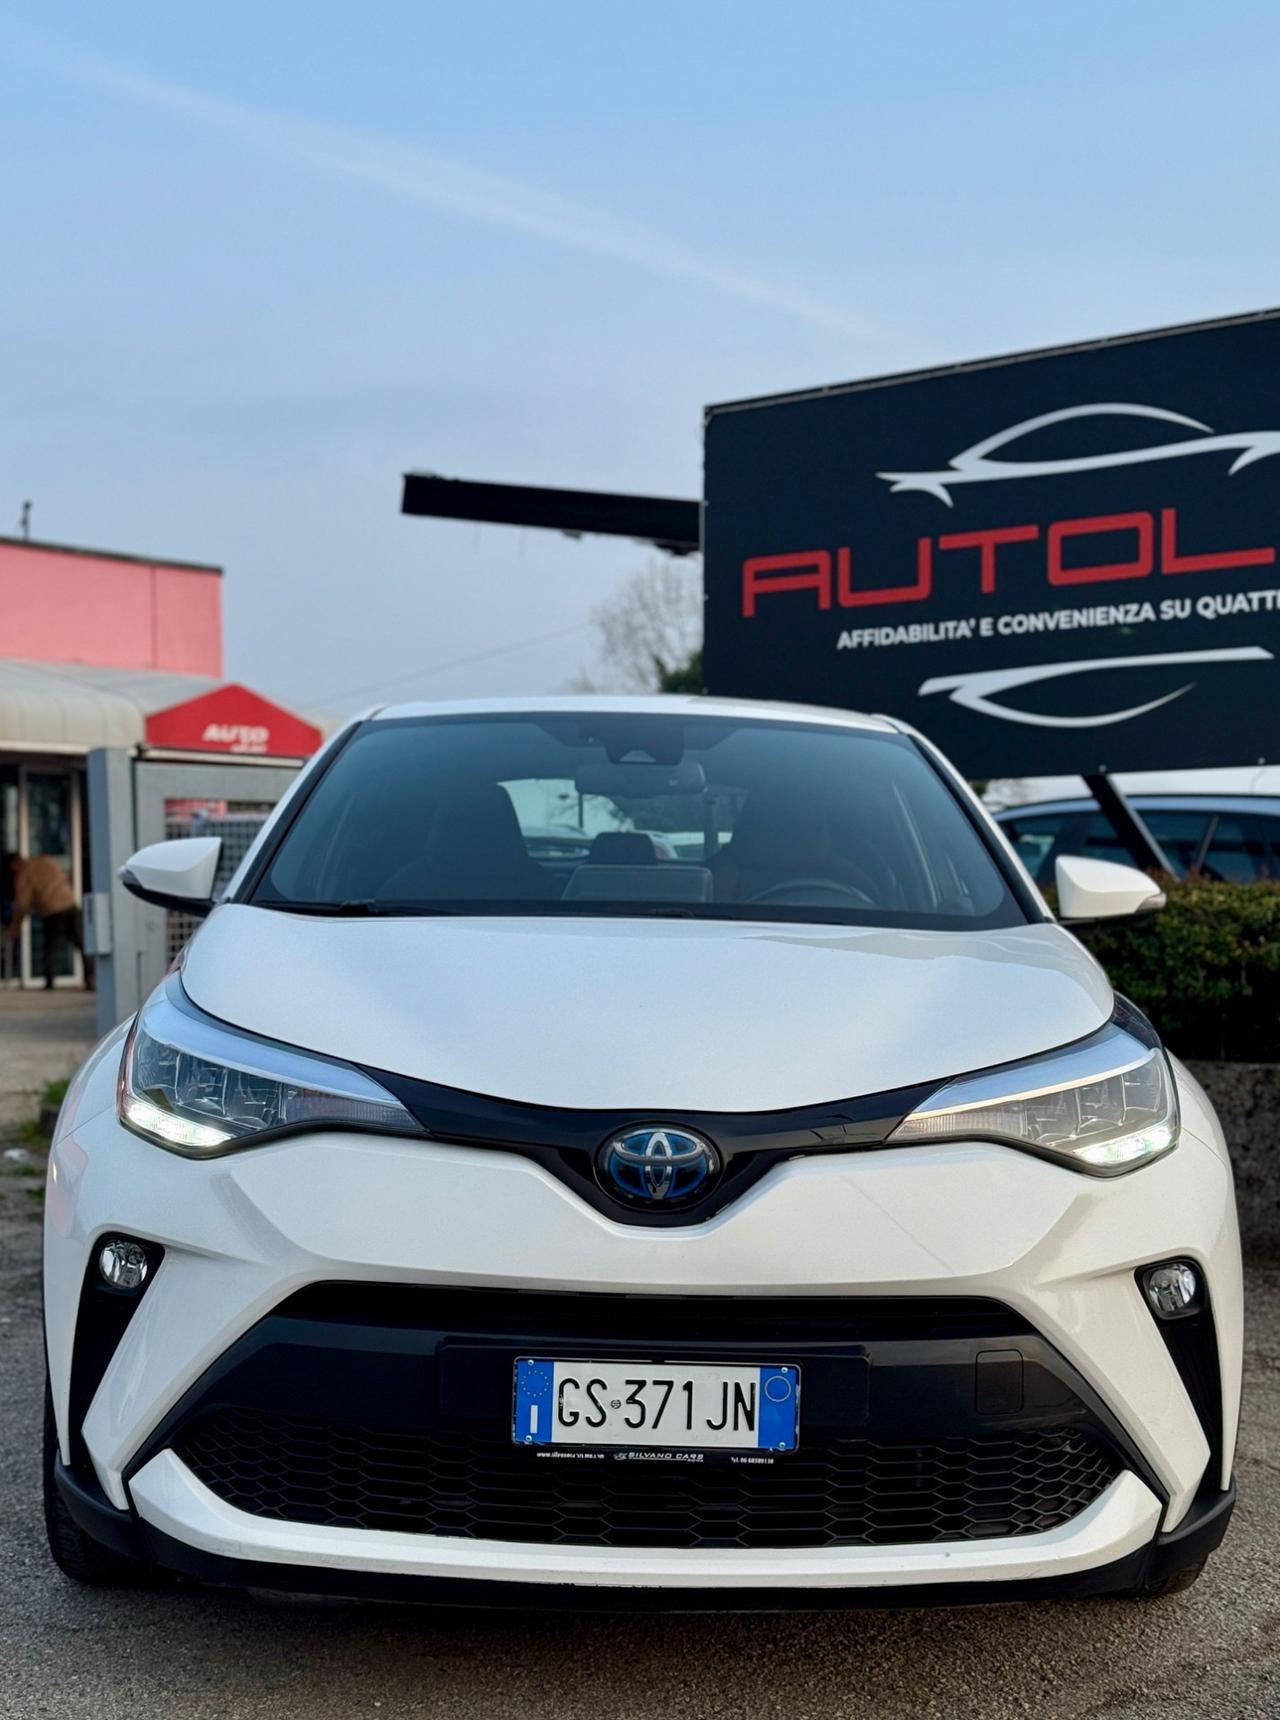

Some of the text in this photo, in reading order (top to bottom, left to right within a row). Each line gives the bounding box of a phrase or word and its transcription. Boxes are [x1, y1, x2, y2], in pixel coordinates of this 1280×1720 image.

[837, 589, 1280, 650] AFFIDABILITA' E CONVENIENZA SU QUATT
[202, 723, 270, 745] AUTO
[628, 1451, 672, 1461] SILVANO
